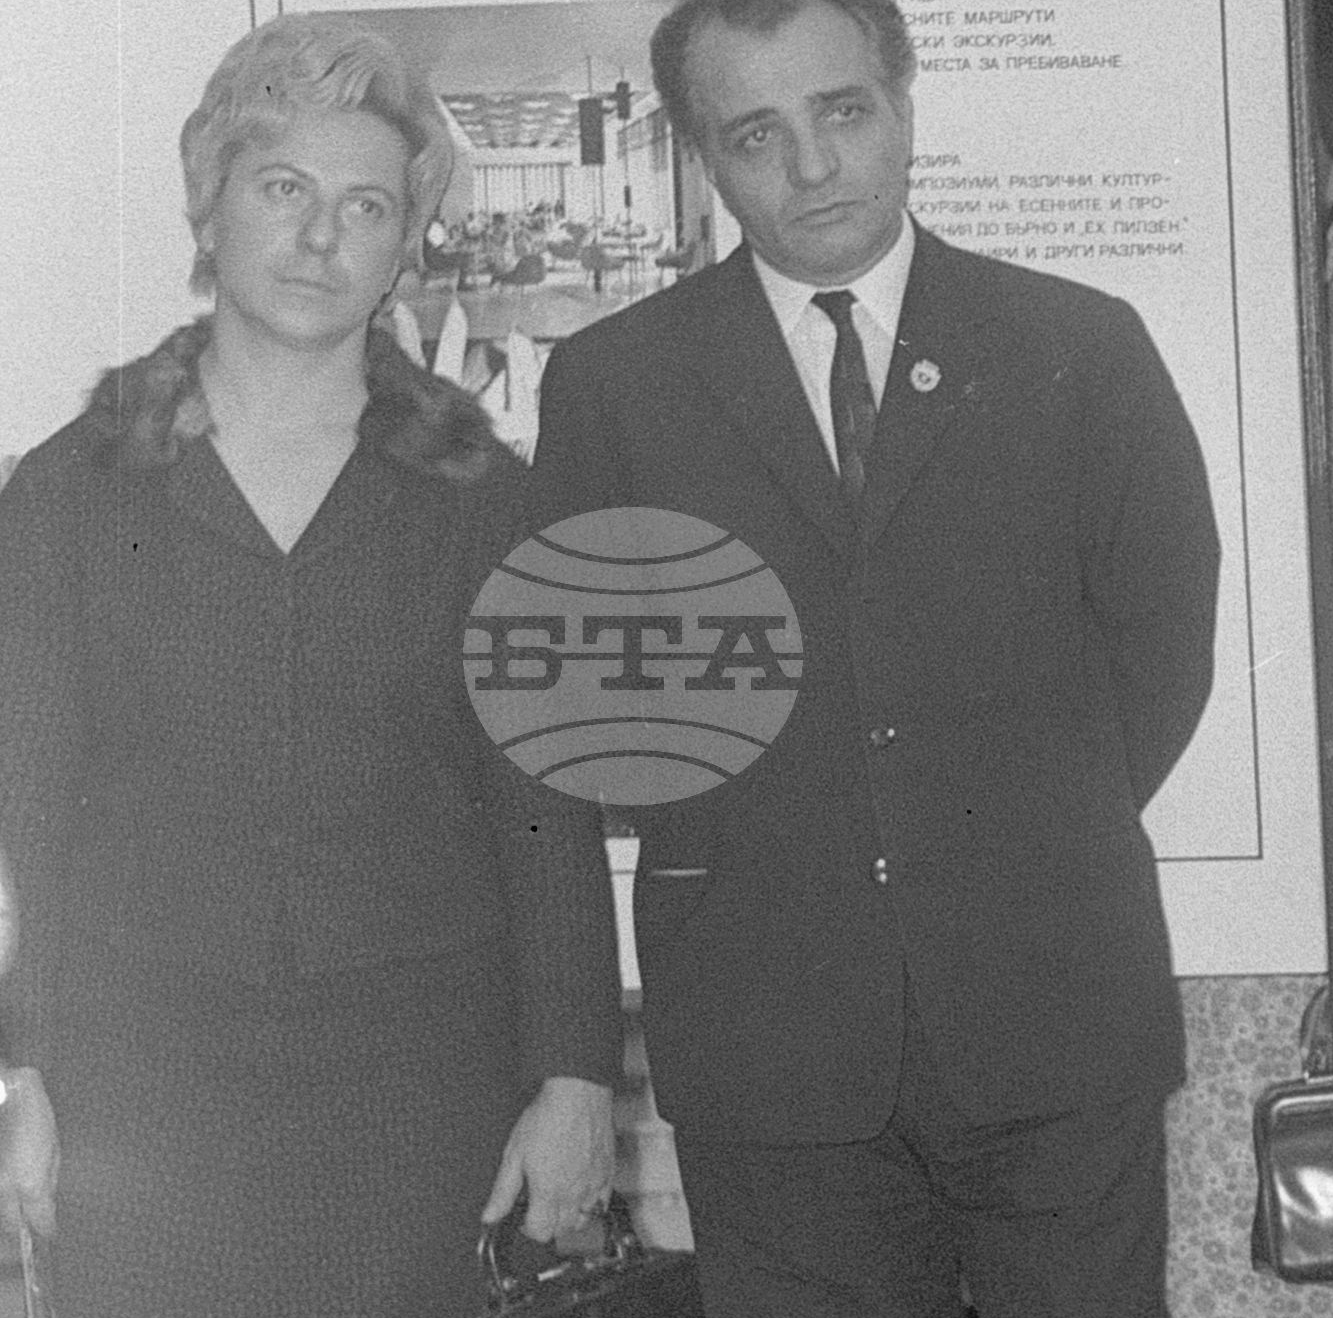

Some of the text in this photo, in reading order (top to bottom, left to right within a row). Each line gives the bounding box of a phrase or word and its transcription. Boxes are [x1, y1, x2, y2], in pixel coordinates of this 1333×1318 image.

[963, 8, 1056, 25] МАРШРУТИ
[920, 57, 971, 73] МЕСТА
[977, 56, 1000, 71] ЗА
[1008, 174, 1092, 189] РАЗЛИЧНИ
[1101, 172, 1172, 188] КУЛТУР-
[988, 199, 1010, 213] НА
[1019, 197, 1102, 213] ЕСЕННИТЕ
[1109, 196, 1122, 212] И
[1128, 195, 1170, 211] ПРО-
[976, 222, 1000, 237] ДО
[1004, 221, 1058, 236] БЪРНО
[1063, 220, 1076, 235] И
[1025, 245, 1038, 259] И
[1044, 243, 1095, 260] ДРУГИ
